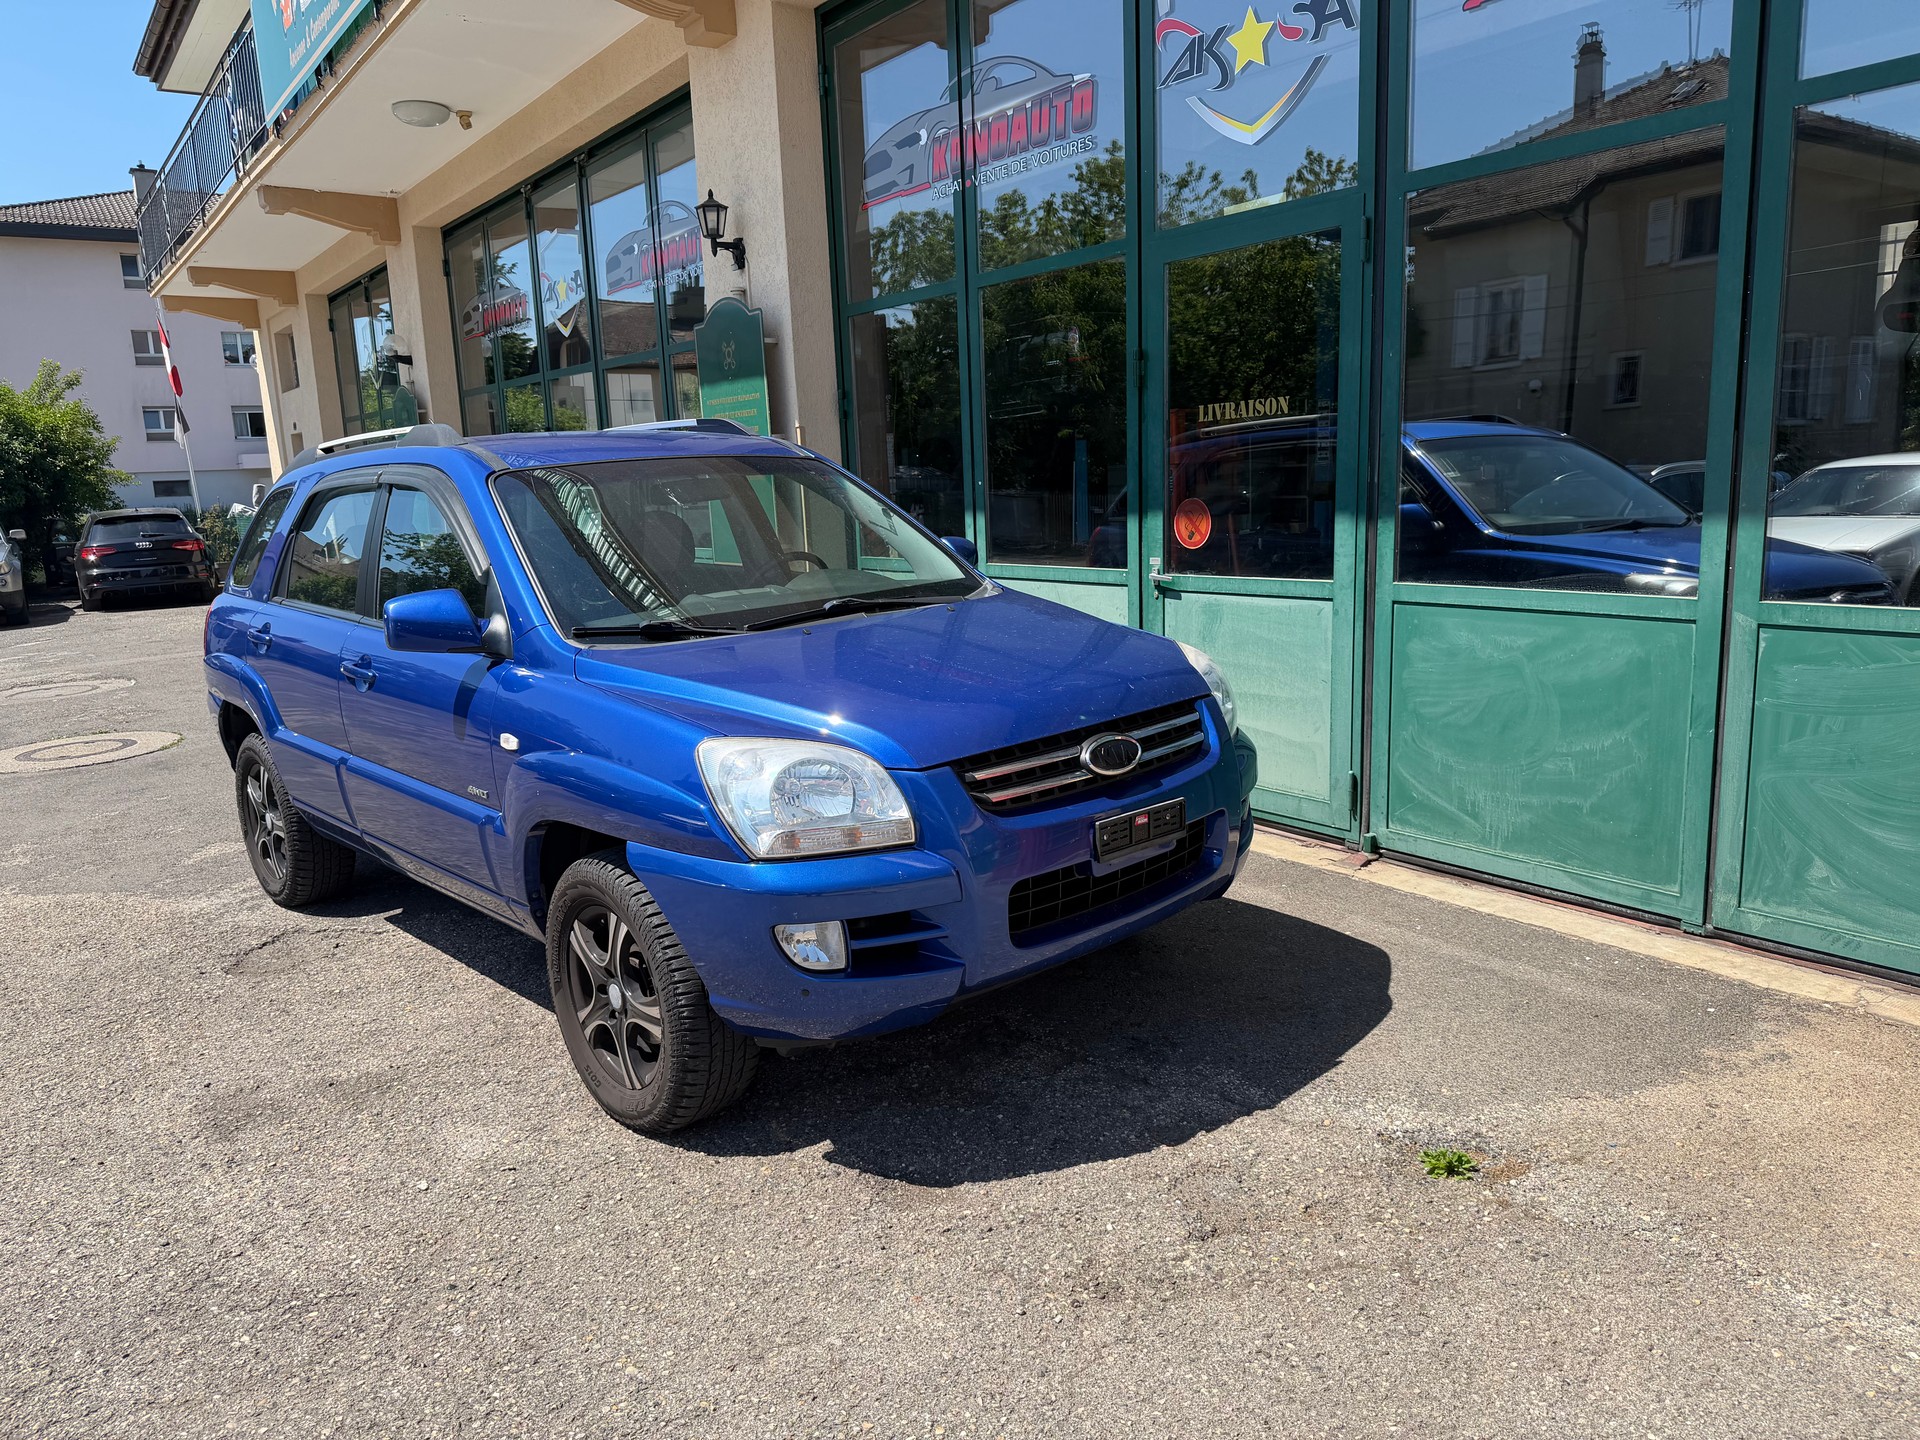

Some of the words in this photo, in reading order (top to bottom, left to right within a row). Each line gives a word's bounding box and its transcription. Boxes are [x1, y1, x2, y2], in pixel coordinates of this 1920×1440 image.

[932, 178, 963, 201] ACHAT
[971, 162, 1008, 188] VENTE
[1011, 156, 1028, 177] DE
[1031, 135, 1094, 169] VOITURES
[1198, 395, 1291, 422] LIVRAISON
